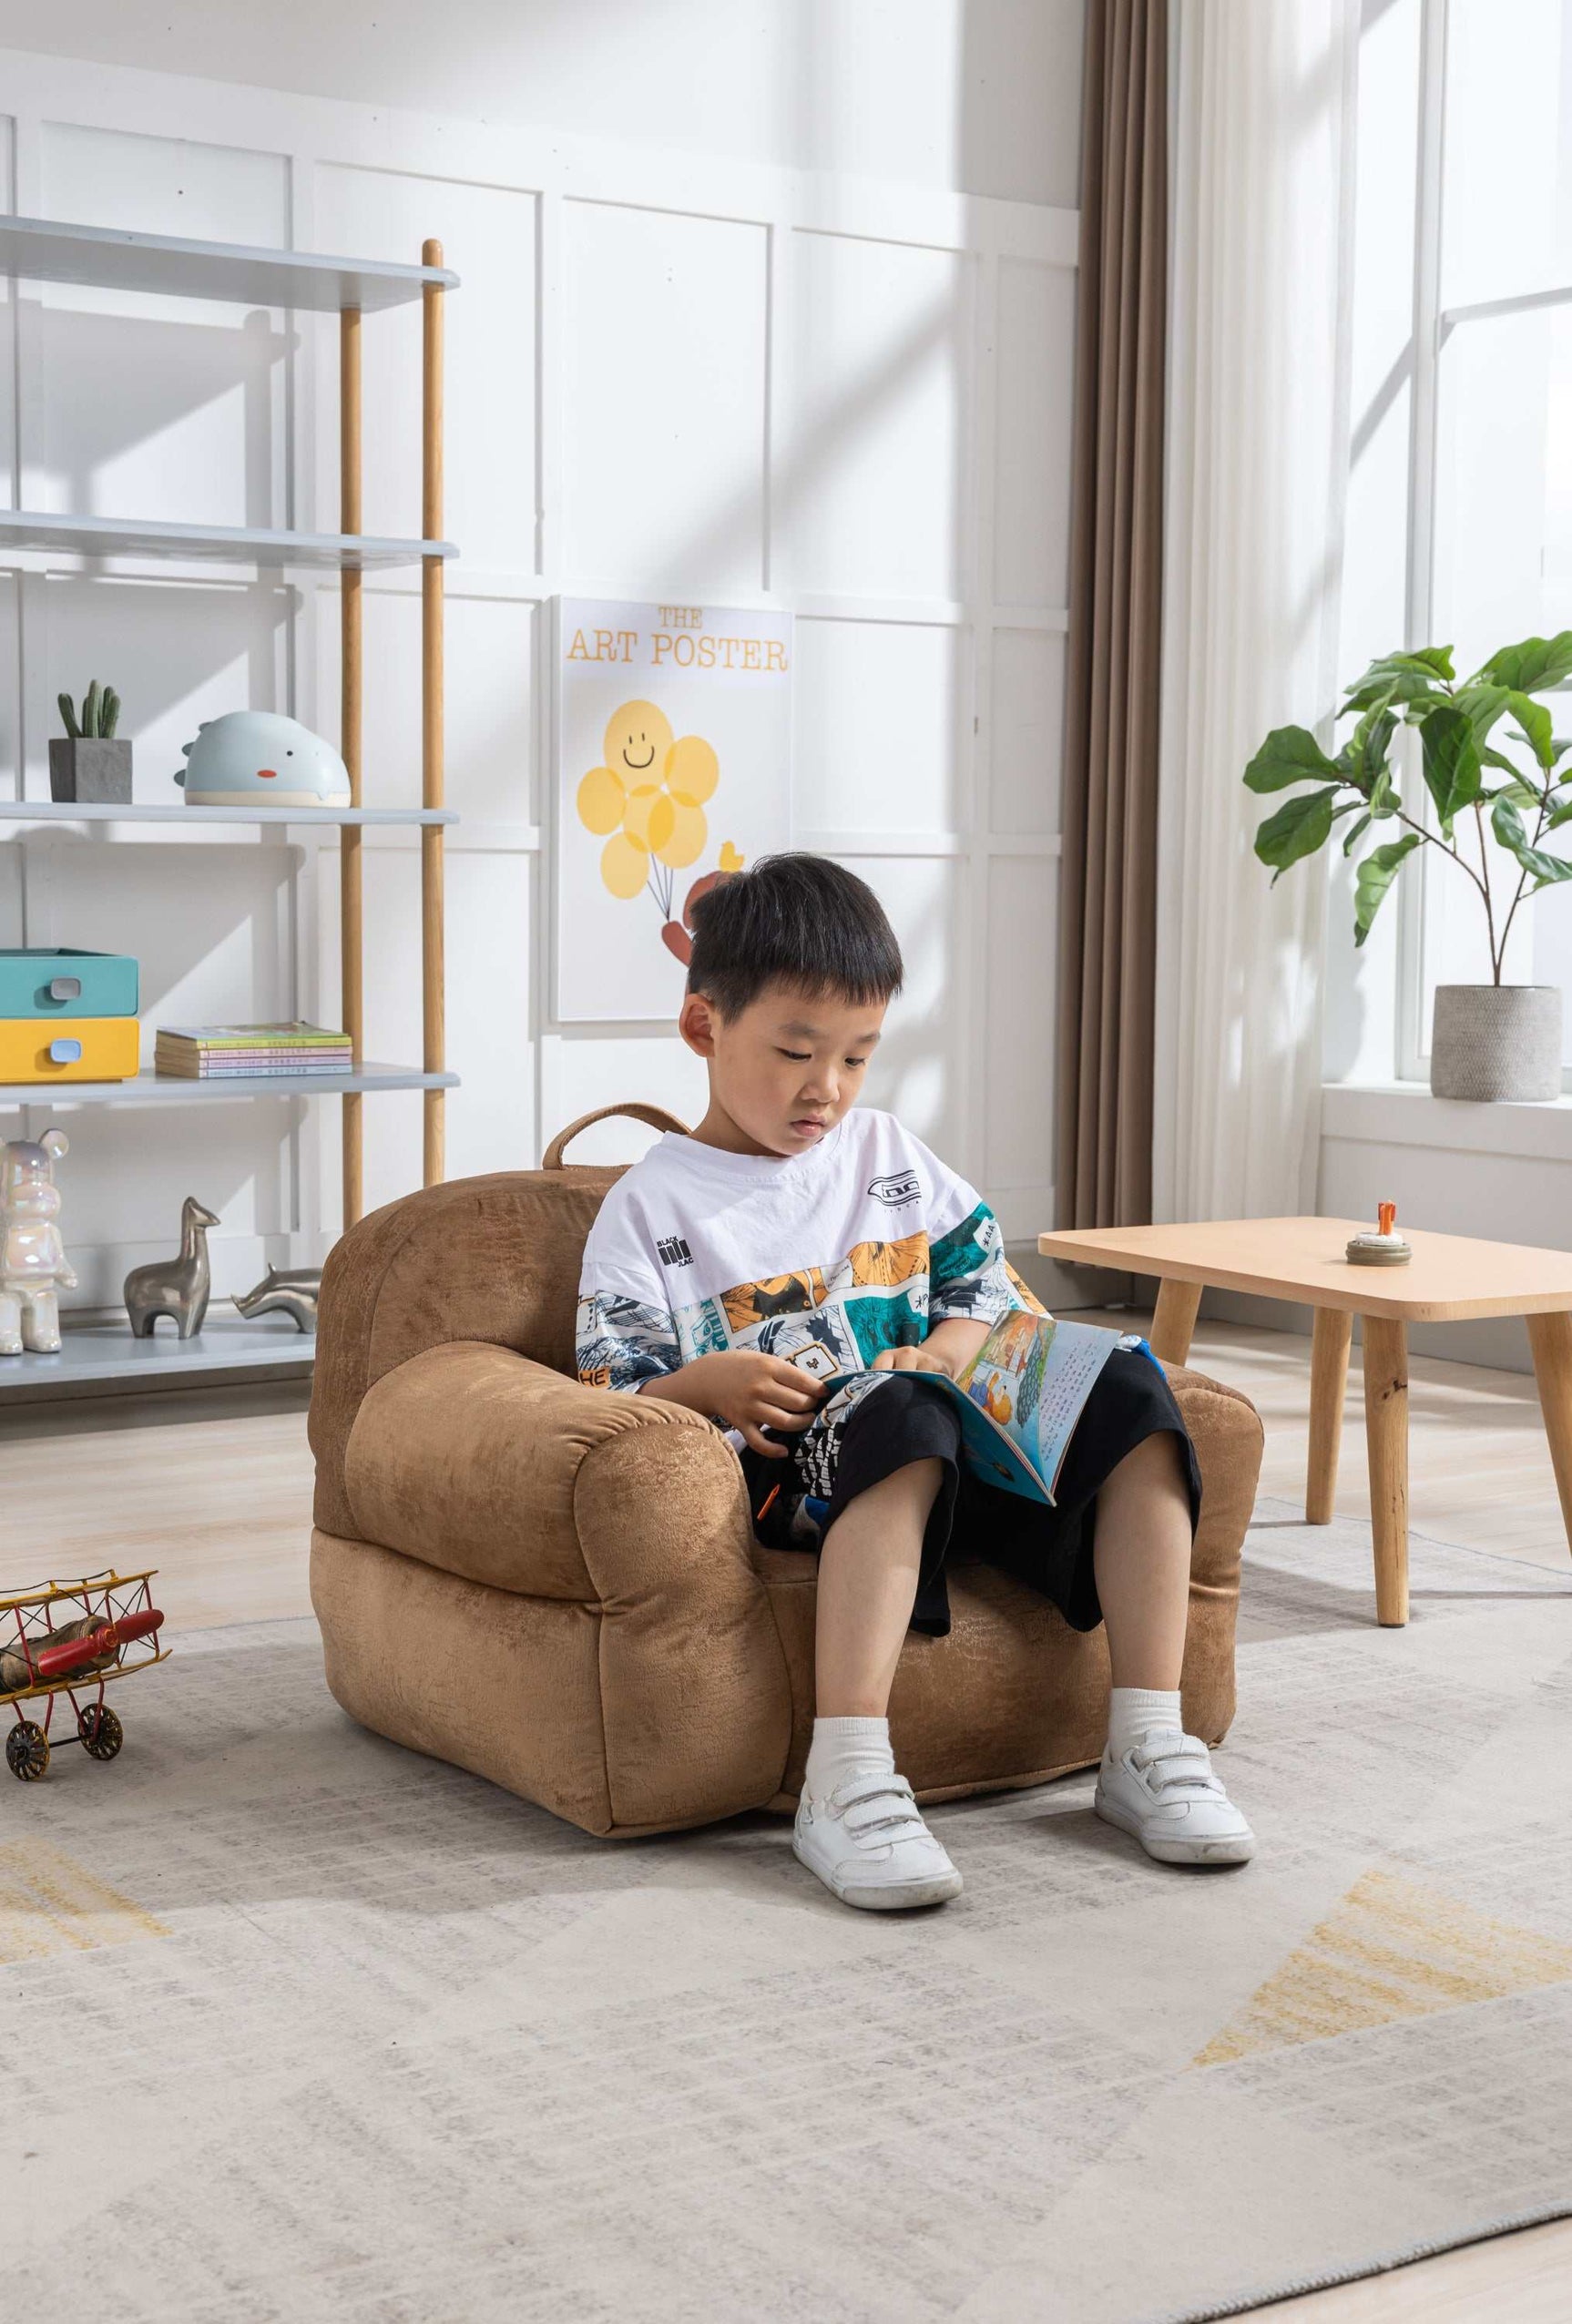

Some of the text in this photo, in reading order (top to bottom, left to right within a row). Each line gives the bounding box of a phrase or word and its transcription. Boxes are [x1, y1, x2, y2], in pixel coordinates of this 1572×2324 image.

[658, 606, 703, 629] THE
[567, 628, 788, 672] ART POSTER
[656, 1235, 679, 1248] BLACK
